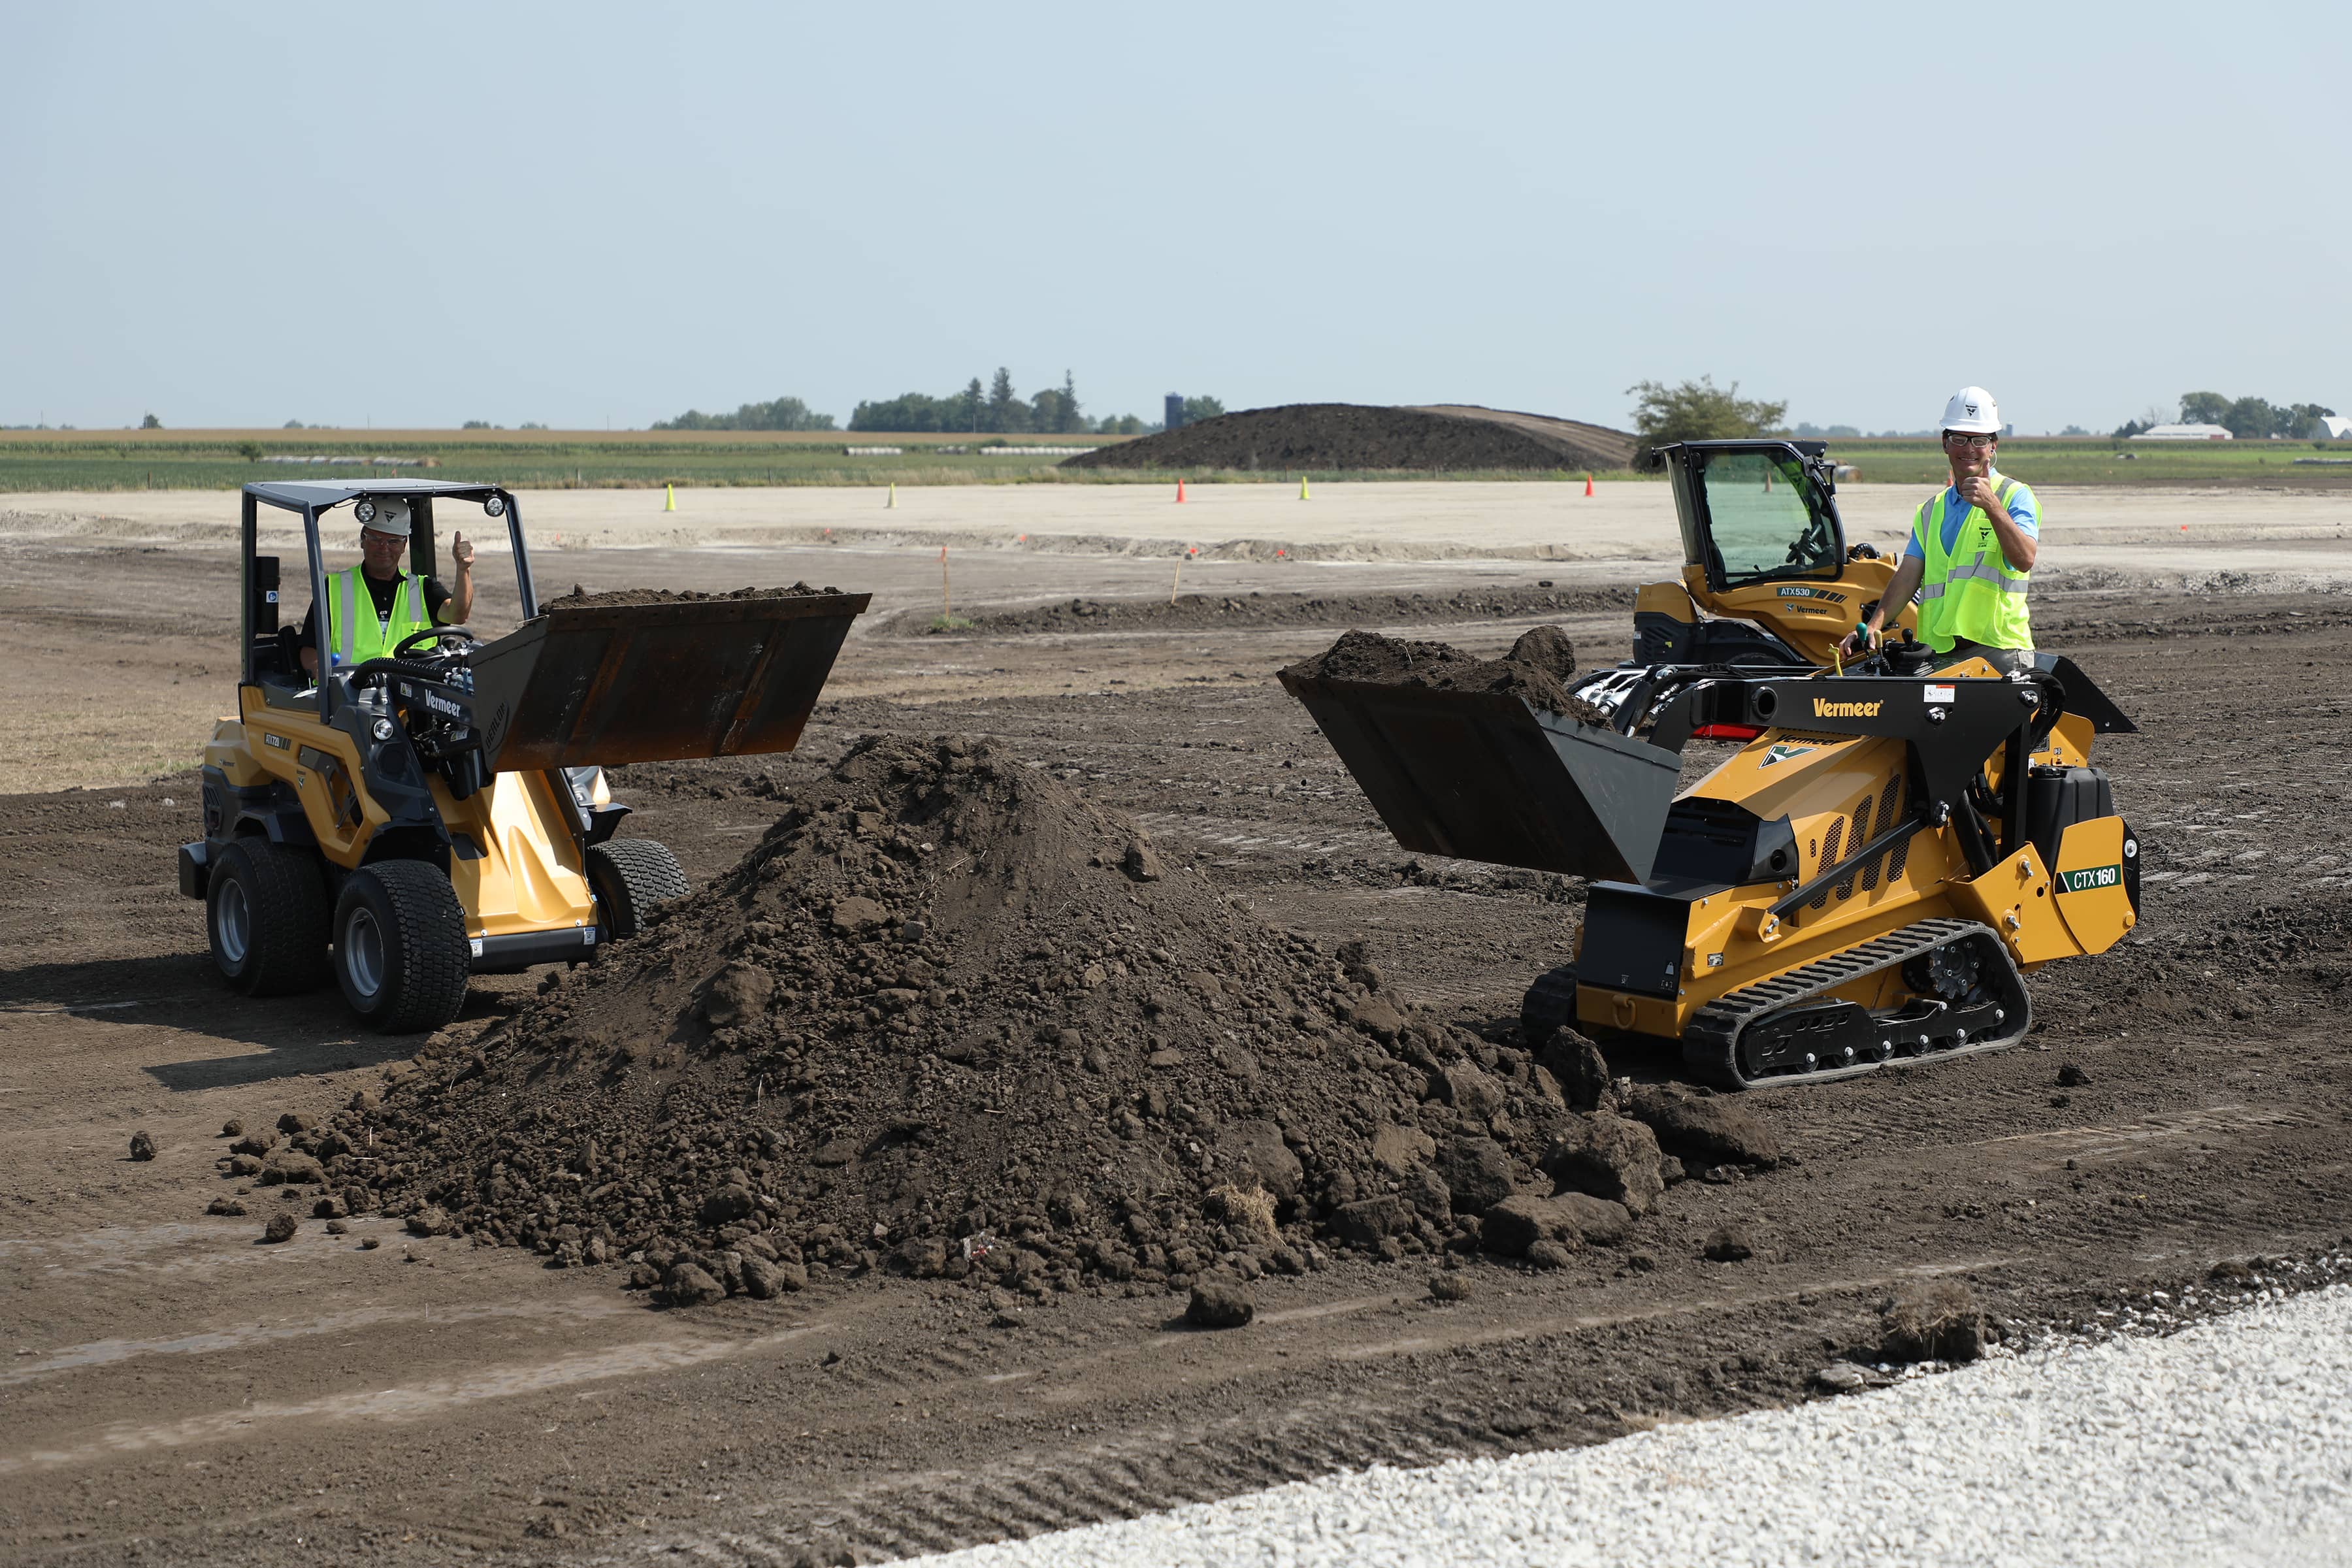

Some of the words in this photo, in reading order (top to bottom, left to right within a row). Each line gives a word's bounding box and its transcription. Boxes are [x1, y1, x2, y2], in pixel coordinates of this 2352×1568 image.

[1781, 587, 1810, 596] ATX530
[1797, 606, 1827, 615] Vermeer
[425, 689, 461, 717] Vermeer
[1813, 698, 1881, 717] Vermeer
[1776, 734, 1840, 746] Vermeer
[2074, 868, 2116, 889] CTX160
